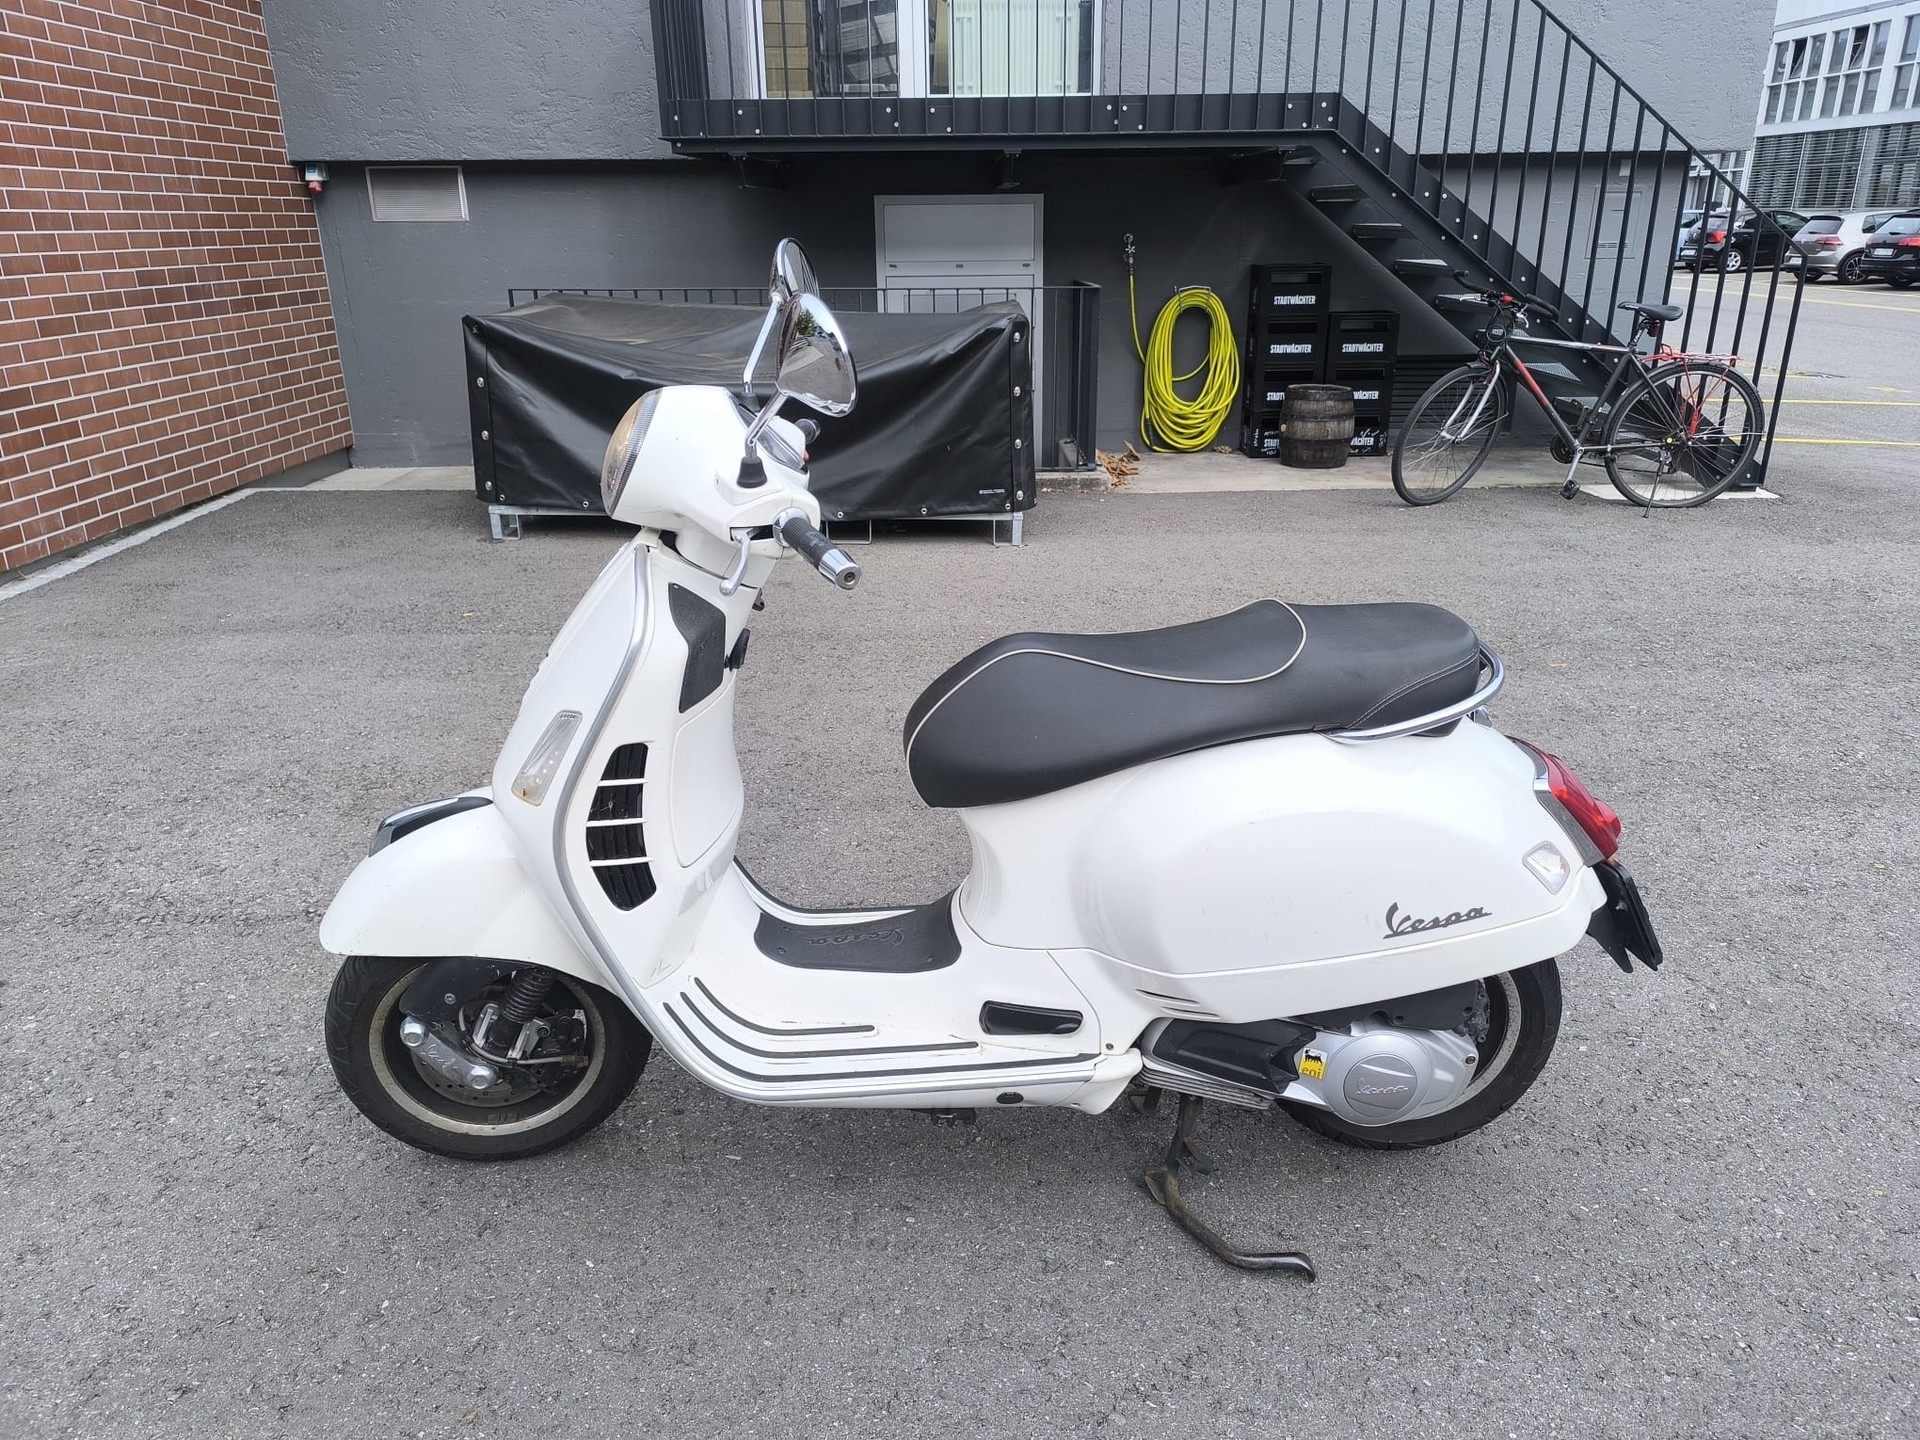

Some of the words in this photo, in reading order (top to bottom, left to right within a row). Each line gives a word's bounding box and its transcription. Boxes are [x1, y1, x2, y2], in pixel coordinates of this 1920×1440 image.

[1273, 294, 1316, 305] STADTWÄCHTER
[1270, 343, 1312, 354] STADTWÄCHTER
[1342, 342, 1384, 353] STADTWÄCHTER
[1382, 901, 1493, 940] Vespa
[1355, 1077, 1409, 1095] Vespa
